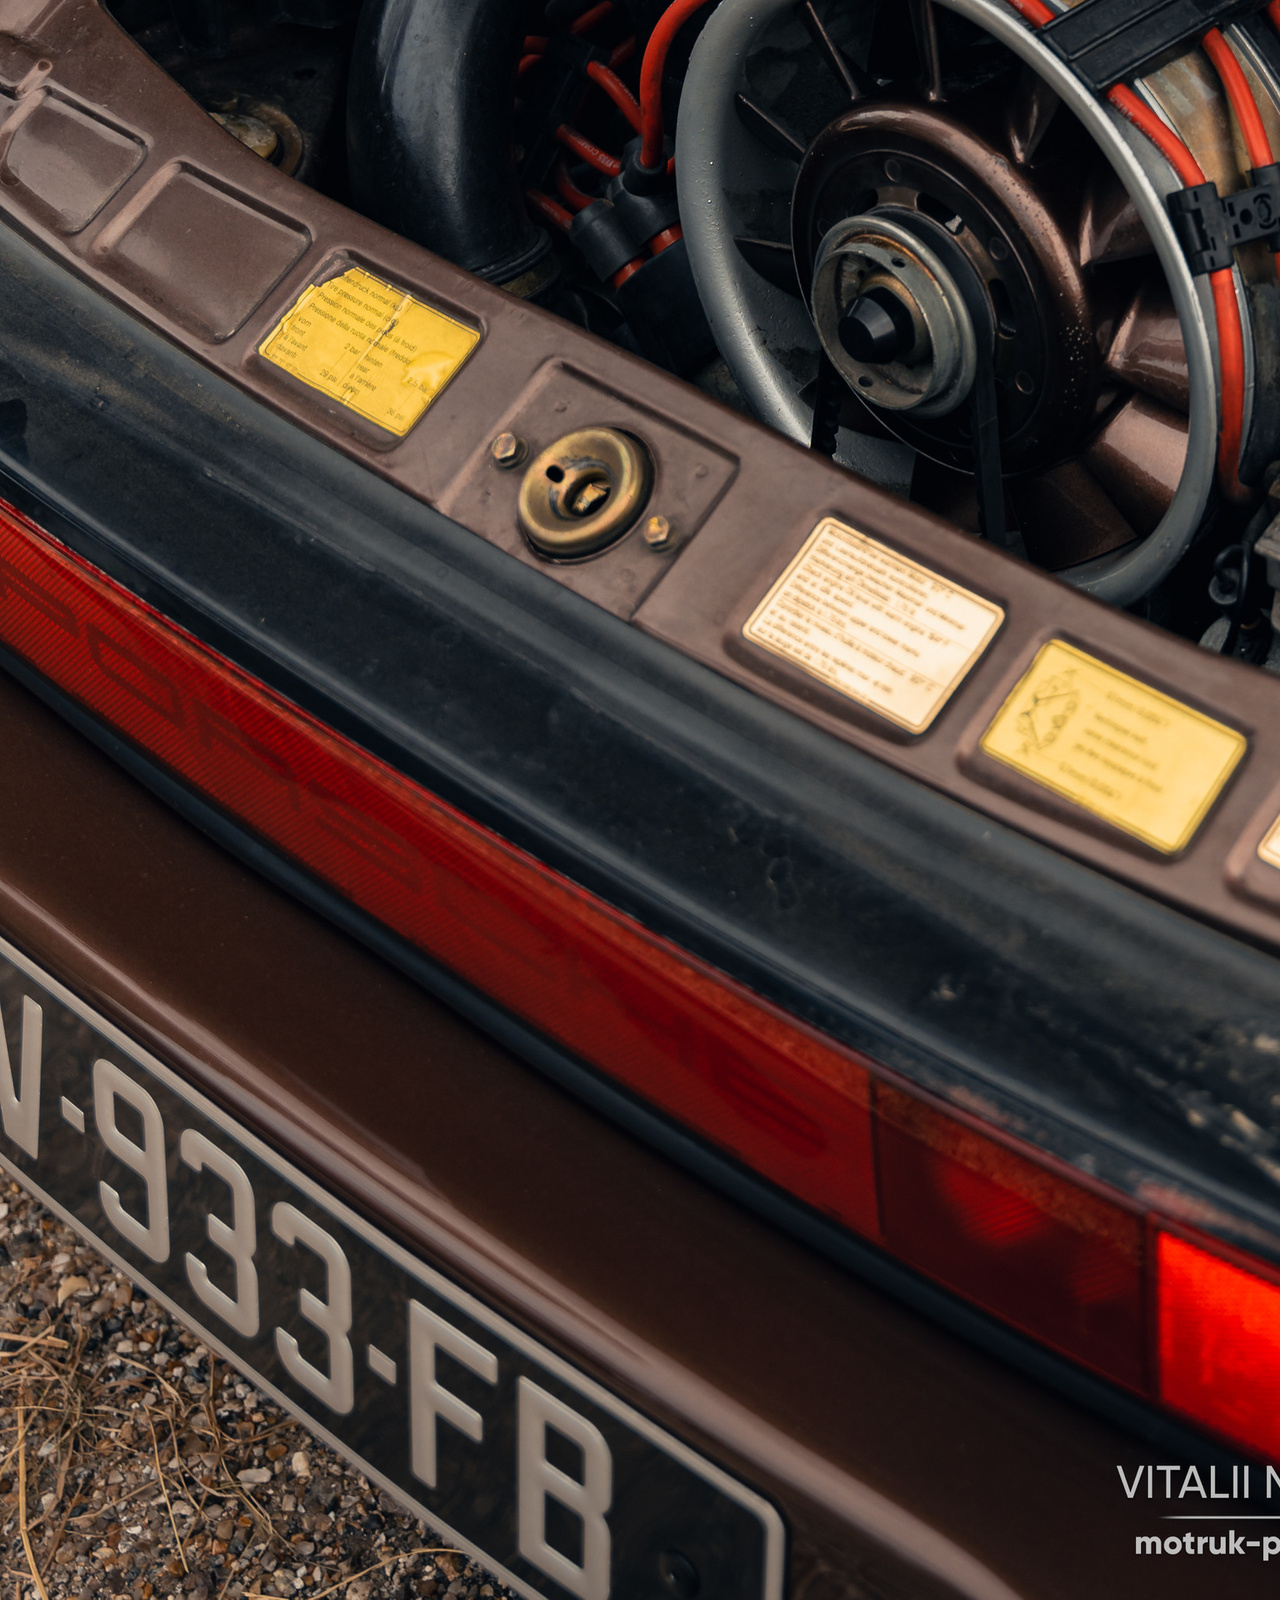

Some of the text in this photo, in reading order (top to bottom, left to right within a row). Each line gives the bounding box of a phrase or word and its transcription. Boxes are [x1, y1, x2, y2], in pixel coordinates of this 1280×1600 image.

[327, 280, 339, 292] Tire
[337, 289, 363, 306] pressure
[362, 303, 383, 317] normal
[339, 273, 369, 292] eifendruck
[369, 291, 391, 305] normal
[289, 324, 306, 336] front
[298, 316, 312, 327] vorn
[349, 346, 361, 355] bar
[308, 302, 335, 322] Pressione
[335, 320, 350, 331] della
[350, 328, 366, 340] ruota
[389, 349, 411, 366] (freddo
[317, 291, 342, 309] Pression
[341, 307, 365, 323] normale
[365, 320, 377, 330] des
[400, 339, 417, 353] froid)
[357, 364, 370, 374] rear
[363, 353, 383, 367] hinten
